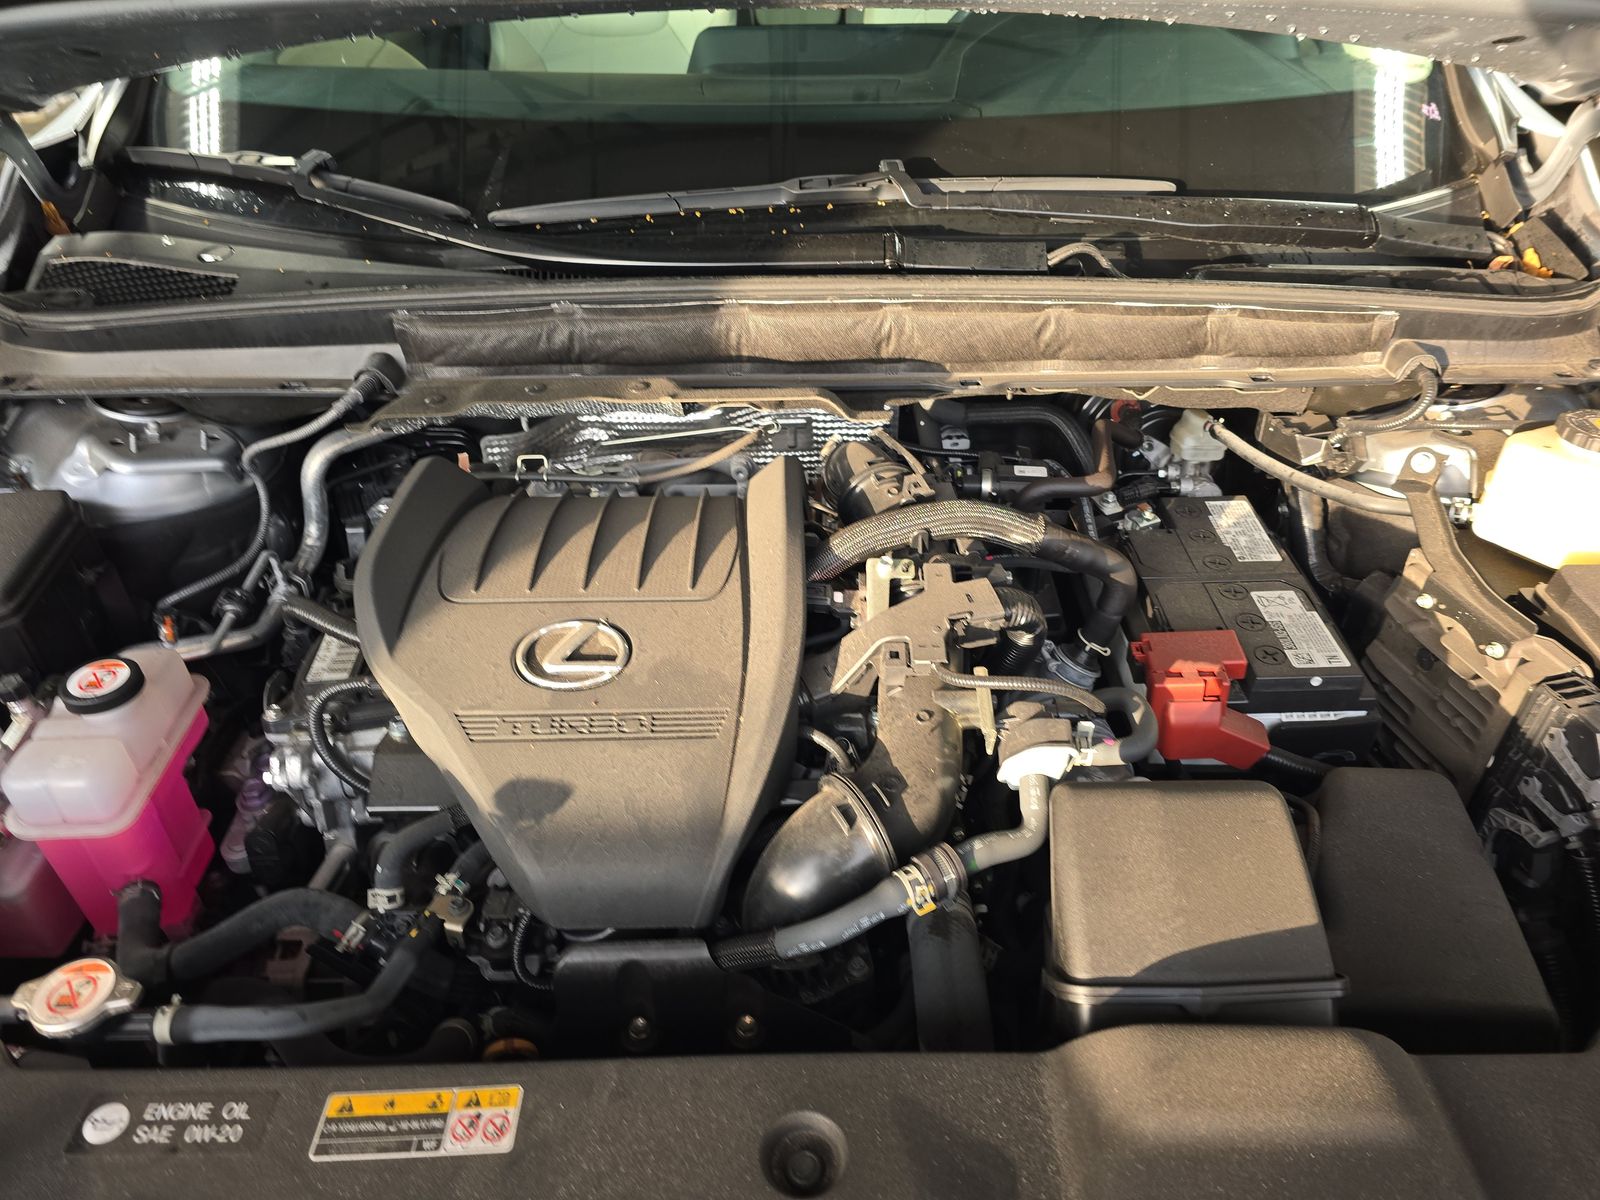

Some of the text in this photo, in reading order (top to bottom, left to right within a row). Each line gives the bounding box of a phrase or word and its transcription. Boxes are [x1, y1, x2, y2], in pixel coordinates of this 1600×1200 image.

[502, 715, 647, 735] TURBO
[143, 1101, 250, 1121] ENGINE OIL
[132, 1123, 243, 1144] SAE 0W-20
